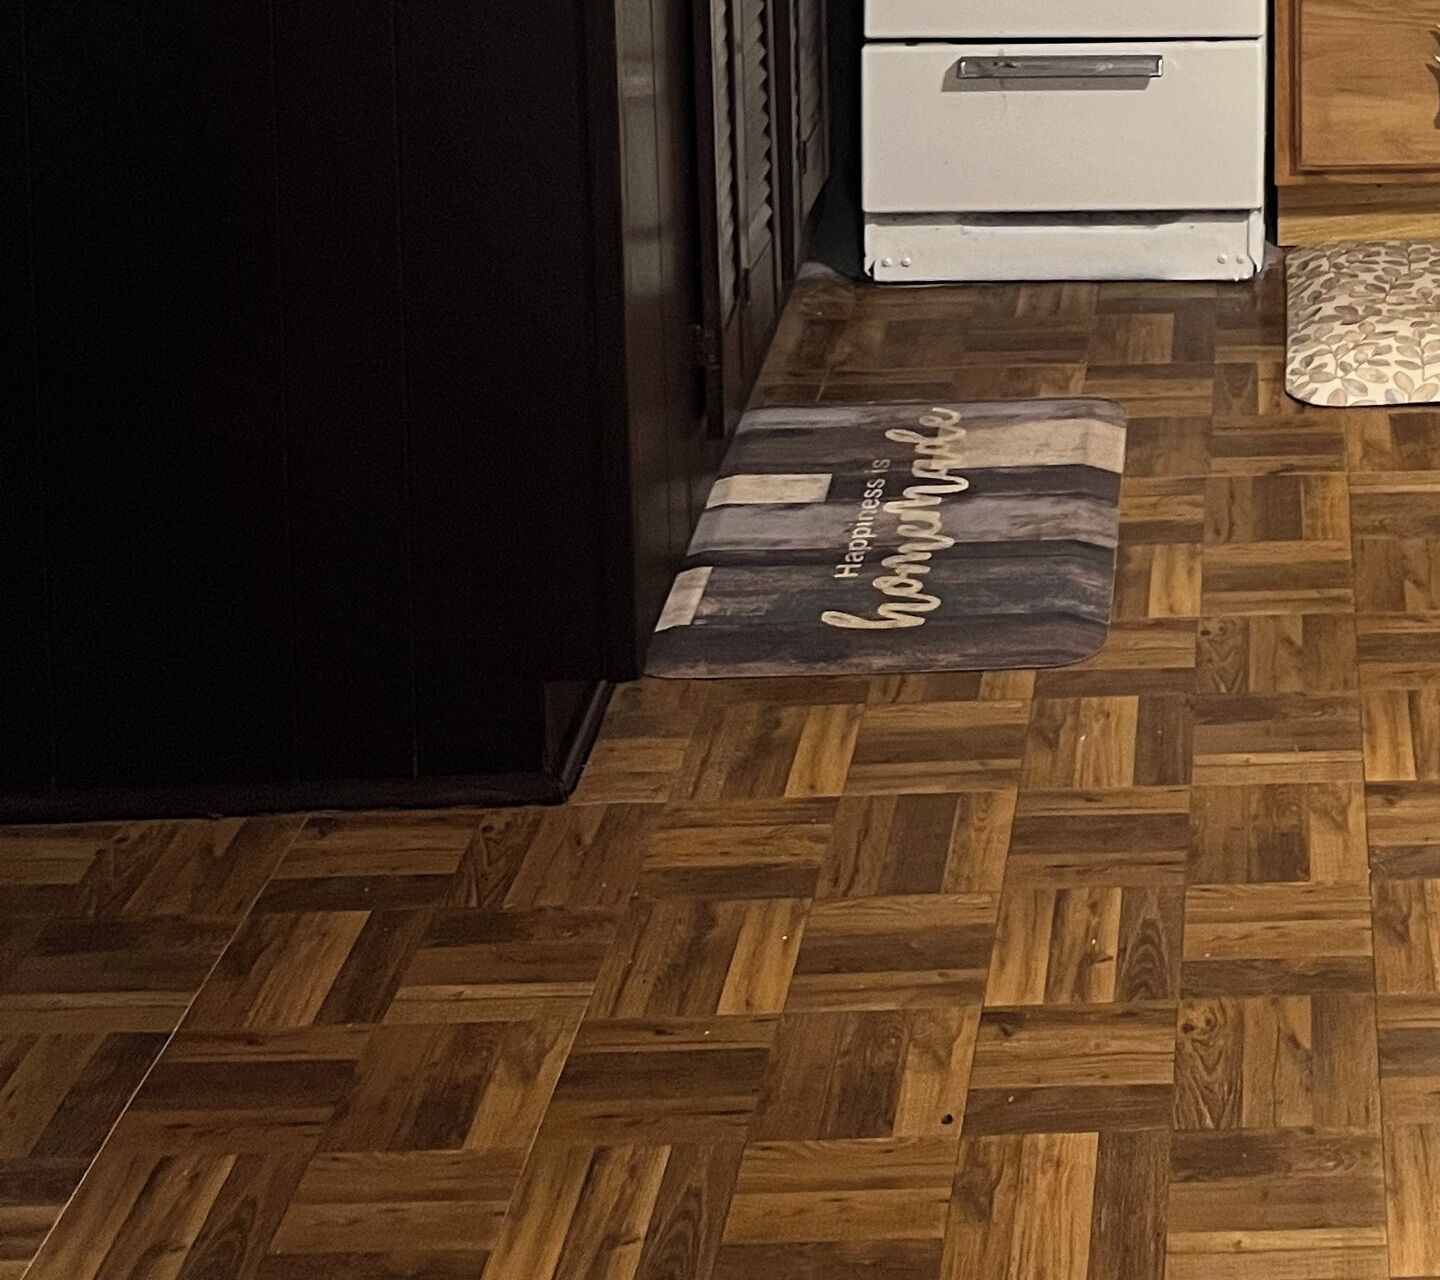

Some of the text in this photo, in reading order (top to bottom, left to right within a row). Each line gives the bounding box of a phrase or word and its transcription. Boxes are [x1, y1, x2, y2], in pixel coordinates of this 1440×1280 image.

[821, 407, 970, 629] homemade
[833, 459, 891, 578] Happiness is
